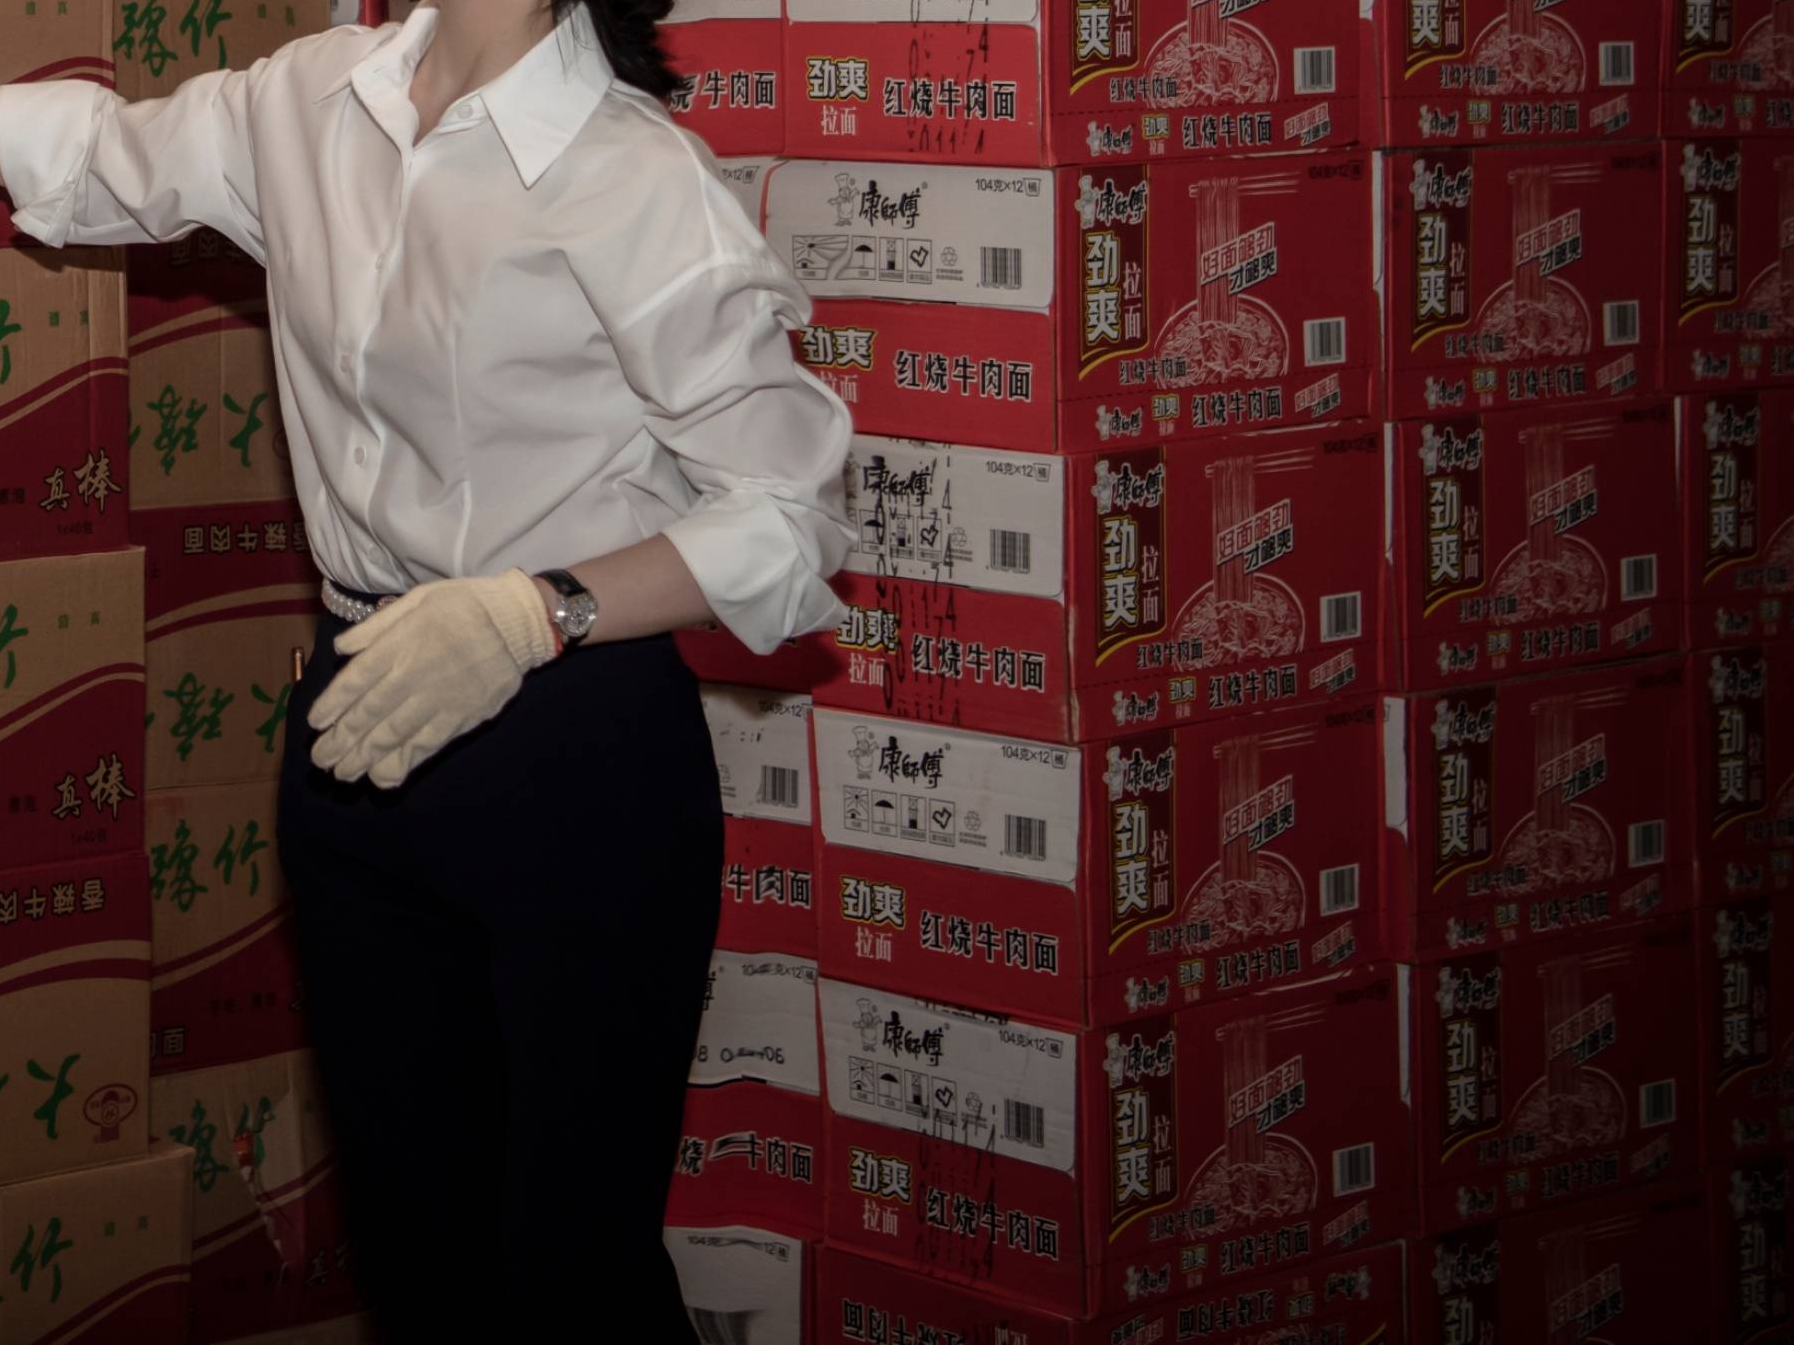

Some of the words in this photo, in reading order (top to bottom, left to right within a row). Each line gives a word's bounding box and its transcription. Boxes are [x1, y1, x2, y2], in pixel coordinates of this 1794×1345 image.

[882, 78, 1020, 122] 红烧牛肉面
[1182, 111, 1272, 150] 红烧牛肉面
[1085, 232, 1121, 345] 劲爽
[894, 350, 1034, 403] 红烧牛肉面
[1191, 386, 1283, 428] 红烧牛肉面
[39, 448, 123, 514] 真棒
[1103, 516, 1139, 632] 劲爽
[1114, 802, 1150, 917] 劲爽
[840, 876, 906, 930] 劲爽
[919, 911, 1060, 974] 红烧牛肉面
[848, 1146, 912, 1202] 劲爽
[925, 1186, 1061, 1261] 红烧牛肉面
